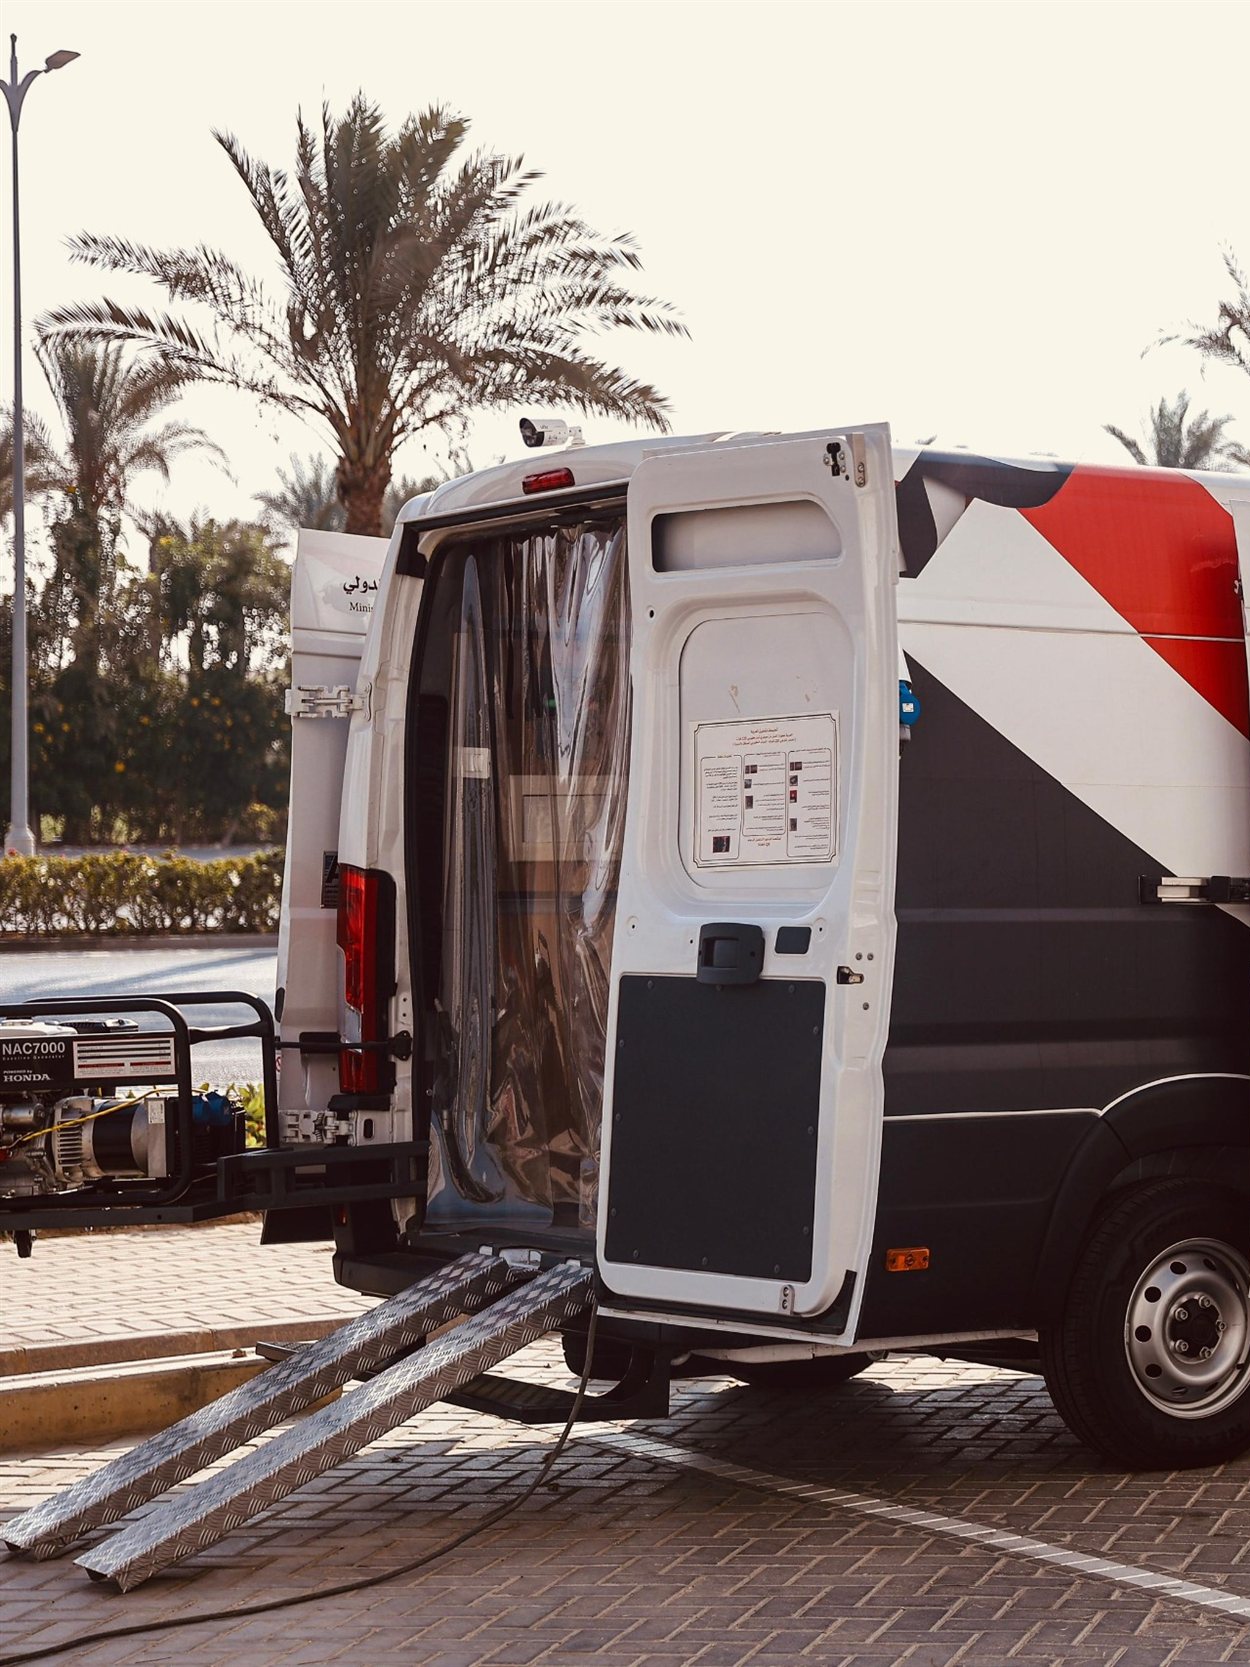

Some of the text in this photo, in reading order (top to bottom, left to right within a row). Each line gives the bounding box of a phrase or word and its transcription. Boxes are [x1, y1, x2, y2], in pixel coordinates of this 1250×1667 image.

[349, 601, 374, 613] Mini
[2, 1041, 66, 1056] NAC7000
[3, 1073, 52, 1082] HONDA
